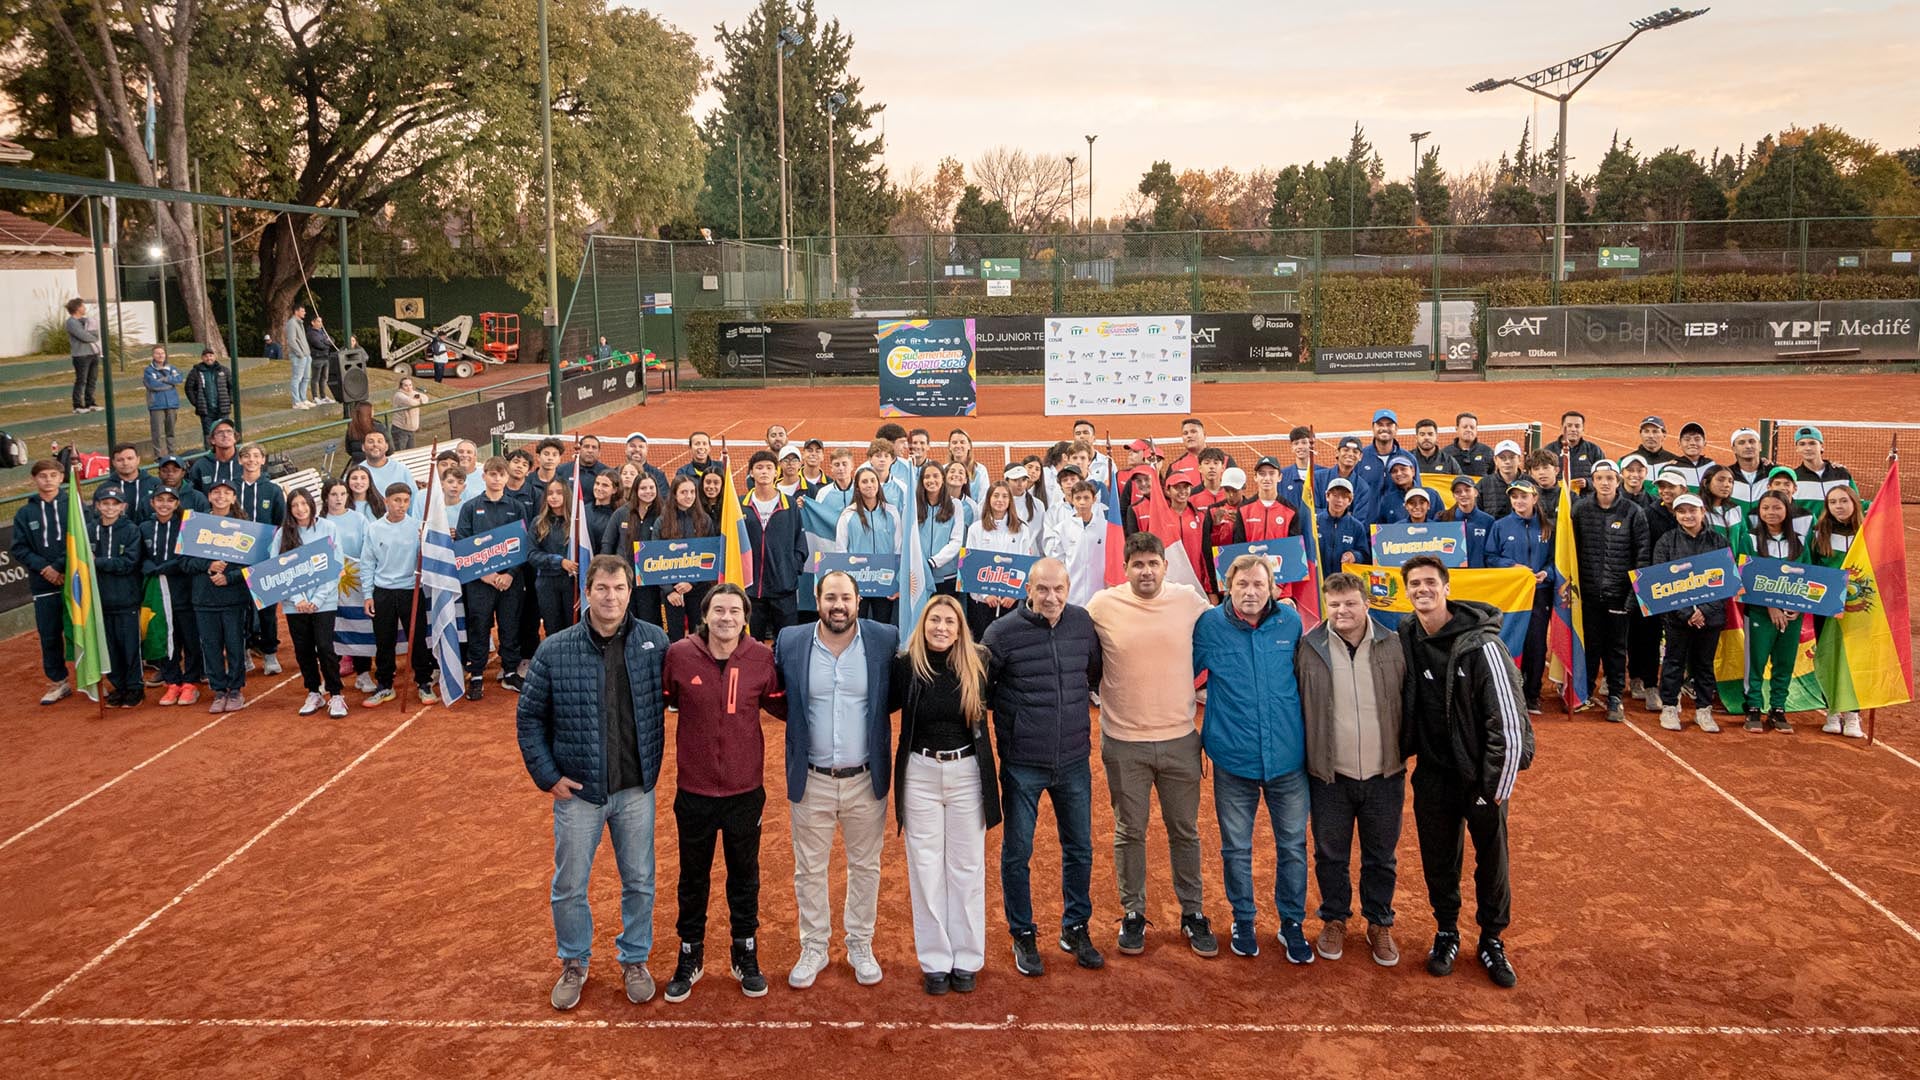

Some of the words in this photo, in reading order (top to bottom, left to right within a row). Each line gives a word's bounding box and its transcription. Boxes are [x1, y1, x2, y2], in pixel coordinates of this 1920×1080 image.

[1498, 317, 1548, 336] AAT
[1768, 321, 1831, 338] YPF
[1838, 319, 1910, 336] Medifé
[996, 332, 1031, 342] JUNIOR
[1528, 349, 1557, 357] Wilson
[902, 360, 940, 370] ROSARIO
[940, 356, 966, 368] 2026
[196, 528, 242, 551] Brasil
[1382, 538, 1444, 555] Venezuela
[454, 540, 509, 570] Paraguay
[643, 552, 702, 572] Colombia
[260, 558, 315, 592] Uruguay
[977, 566, 1010, 584] Chile
[1651, 570, 1710, 599] Ecuador
[1753, 575, 1810, 596] Bolivia
